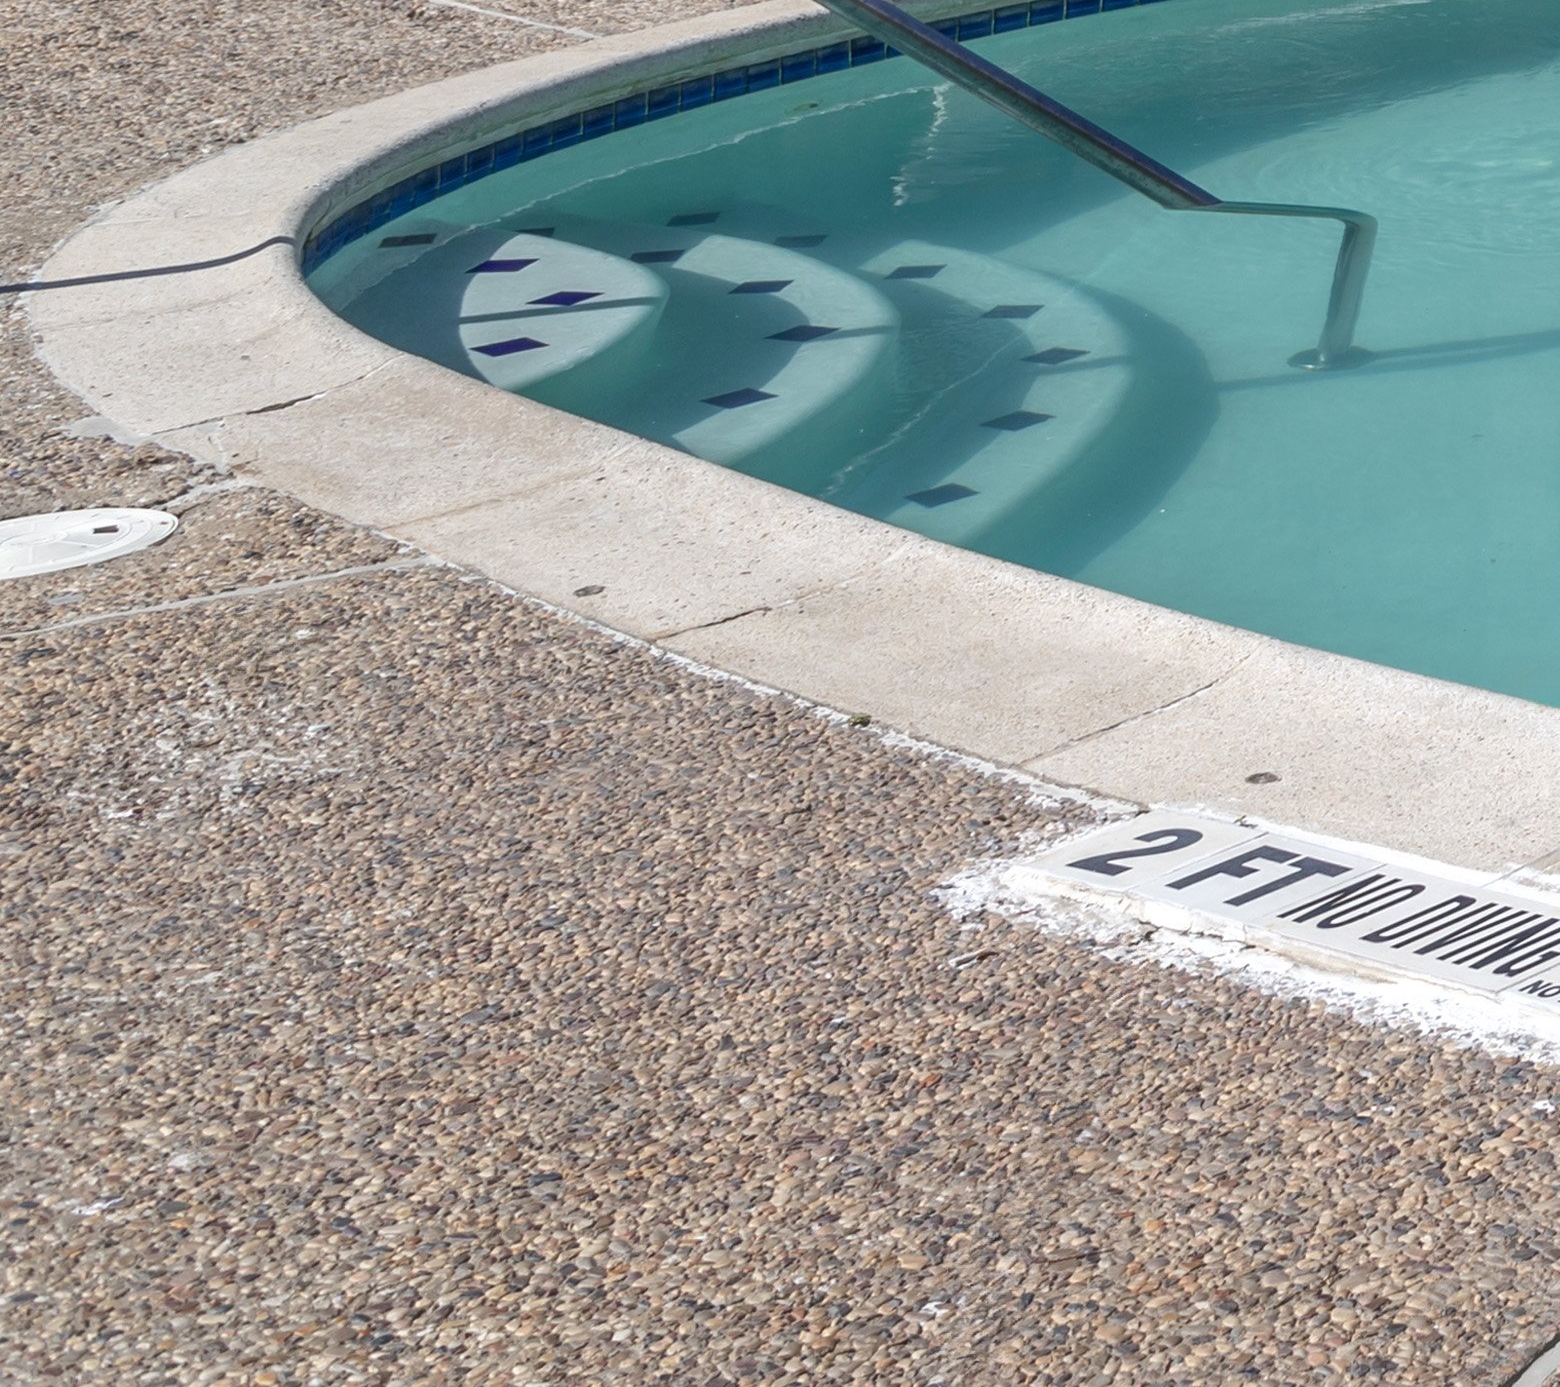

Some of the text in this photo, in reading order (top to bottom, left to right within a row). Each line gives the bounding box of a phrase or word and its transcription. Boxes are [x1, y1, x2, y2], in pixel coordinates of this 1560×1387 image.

[1064, 827, 1204, 877] 2
[1164, 844, 1354, 908] FT
[1275, 873, 1427, 930] NO
